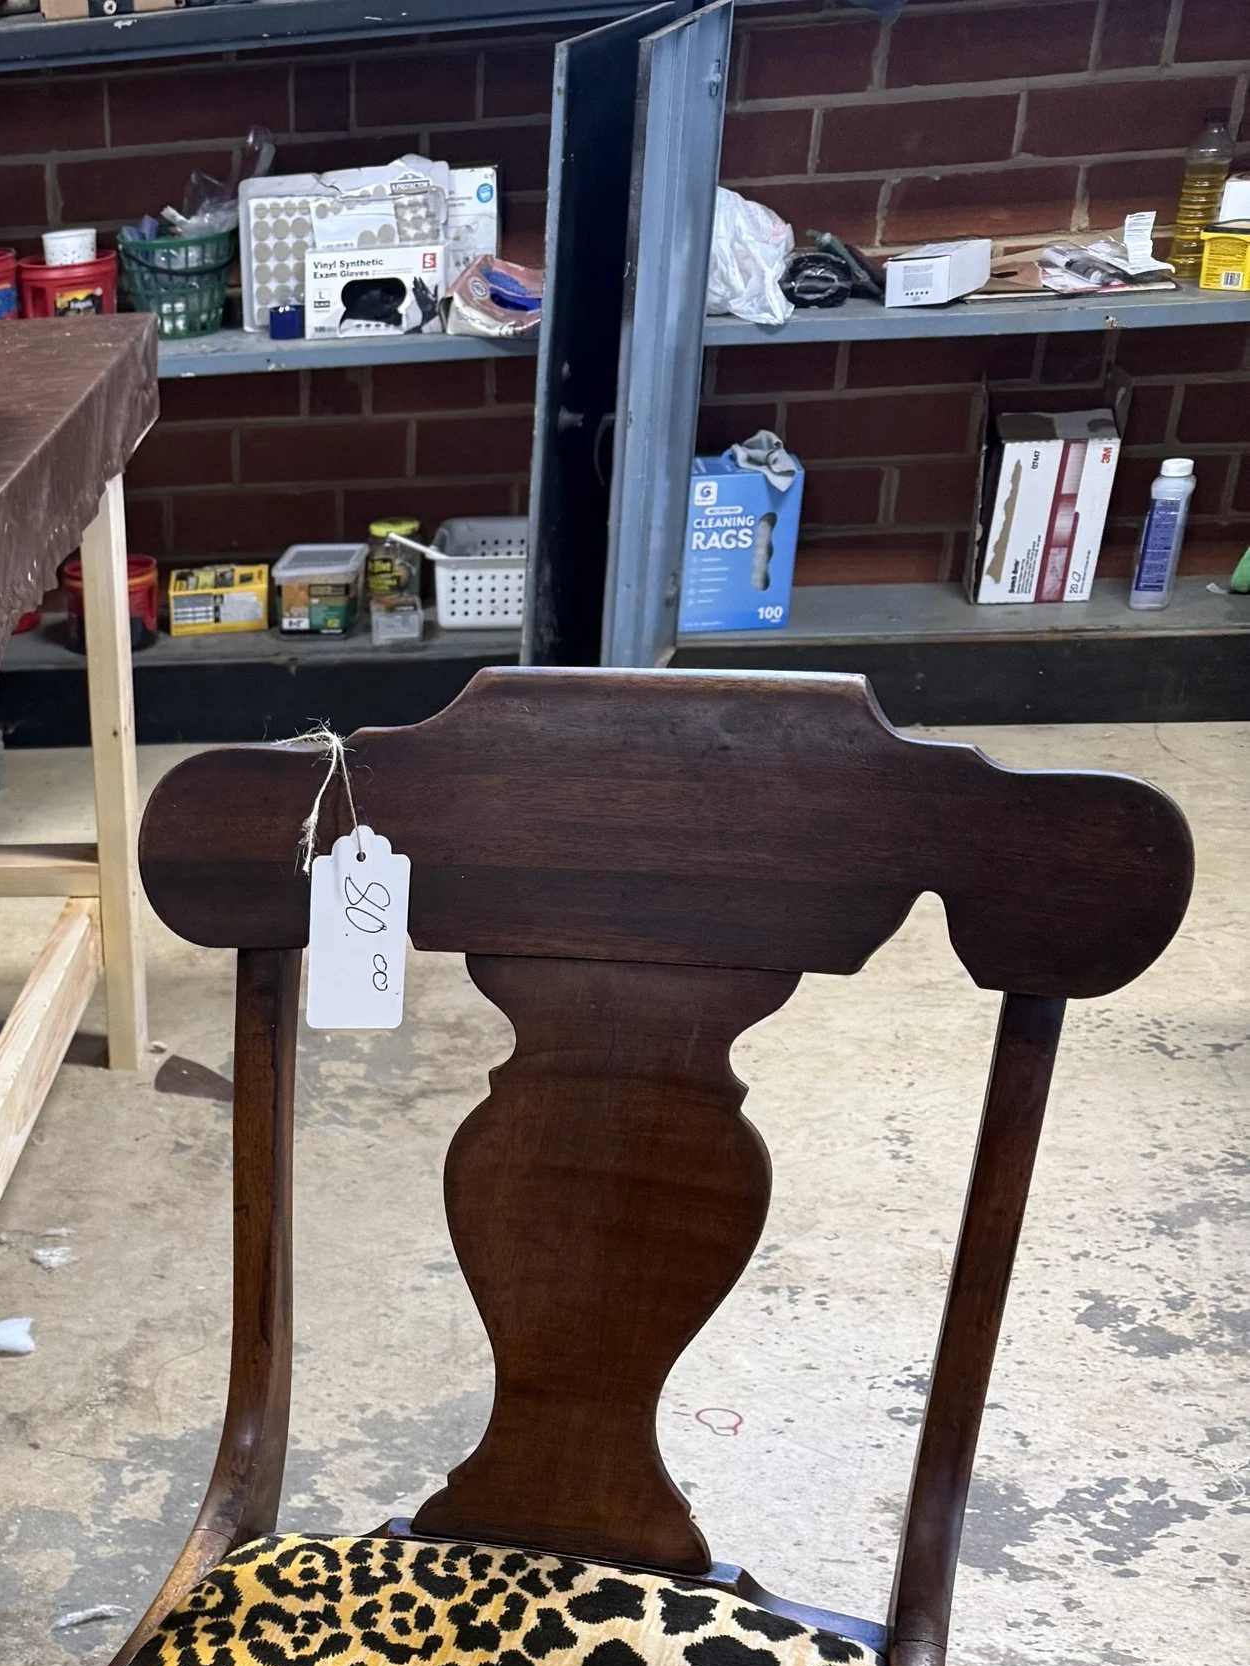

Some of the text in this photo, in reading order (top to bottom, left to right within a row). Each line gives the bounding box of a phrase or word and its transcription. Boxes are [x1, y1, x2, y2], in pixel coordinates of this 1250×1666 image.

[313, 258, 384, 270] Vinyl Synthetic
[314, 271, 337, 279] Exam
[340, 270, 369, 278] Gloves
[1101, 447, 1113, 464] 3M
[693, 515, 755, 529] CLEANING
[692, 528, 753, 550] RAGS
[757, 606, 783, 619] 100
